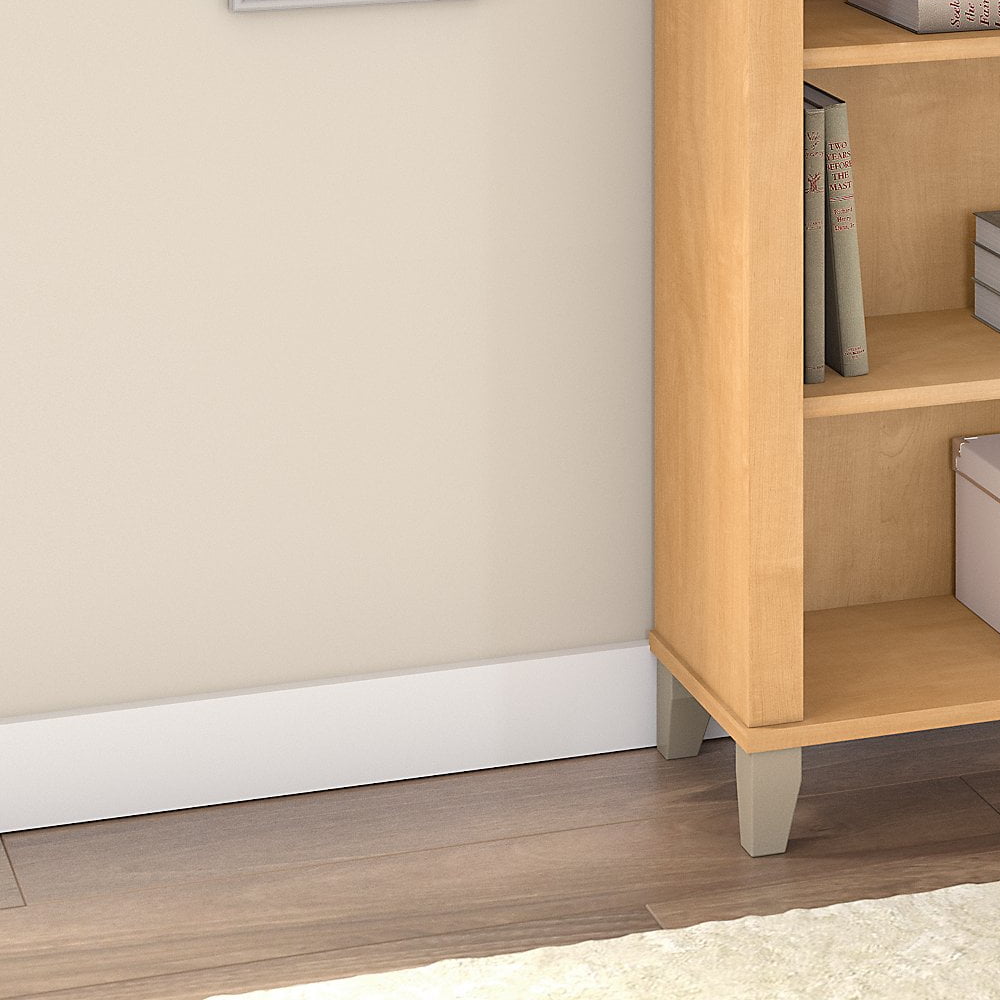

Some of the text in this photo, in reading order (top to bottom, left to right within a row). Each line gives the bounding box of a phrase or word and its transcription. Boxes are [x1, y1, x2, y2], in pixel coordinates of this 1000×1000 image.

[949, 0, 961, 28] Seek
[964, 2, 975, 23] the
[828, 141, 848, 151] TWO
[826, 150, 851, 161] YEARS
[831, 170, 850, 181] THE
[829, 181, 852, 192] MAST
